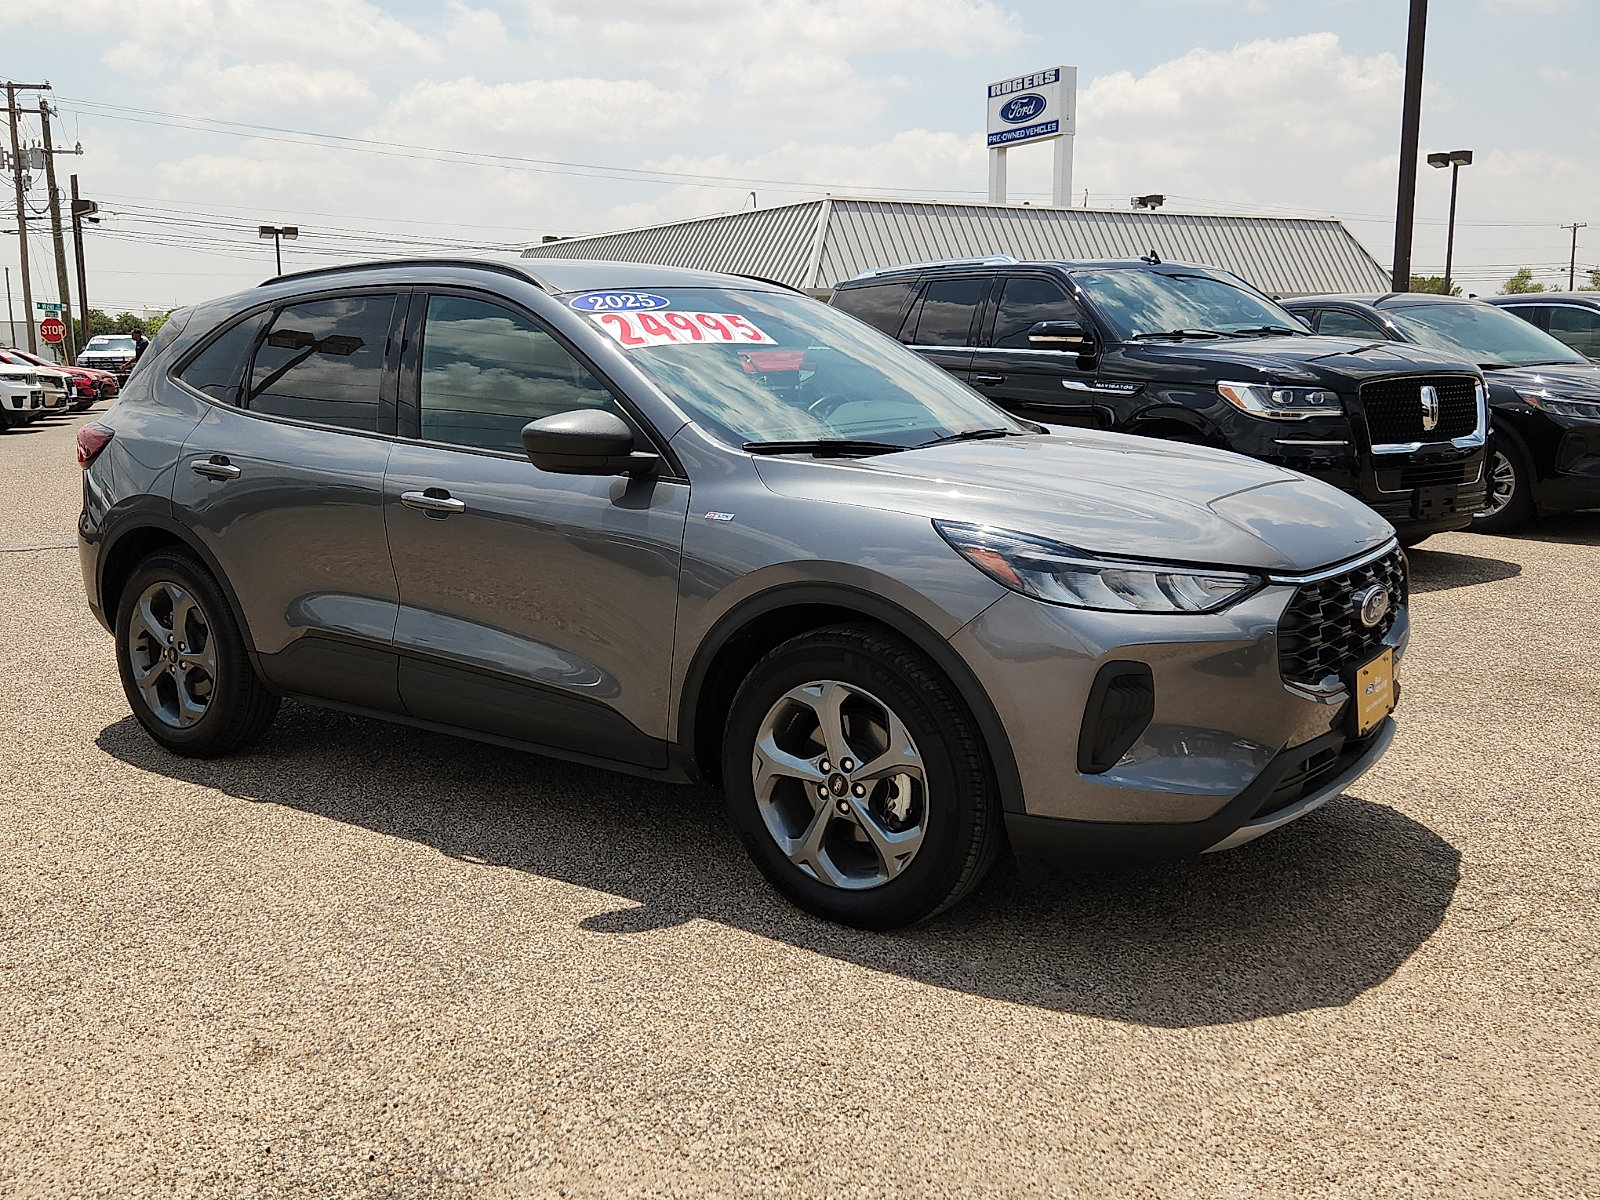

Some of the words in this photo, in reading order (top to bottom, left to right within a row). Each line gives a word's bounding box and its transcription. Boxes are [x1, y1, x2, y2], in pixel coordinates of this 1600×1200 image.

[991, 71, 1056, 96] ROGERS
[1008, 98, 1035, 119] Ford
[988, 130, 1025, 144] PRE-OWNED
[1025, 123, 1057, 136] VEHICLES
[588, 294, 656, 310] 2025
[42, 325, 64, 335] STOP
[601, 313, 765, 346] 24995
